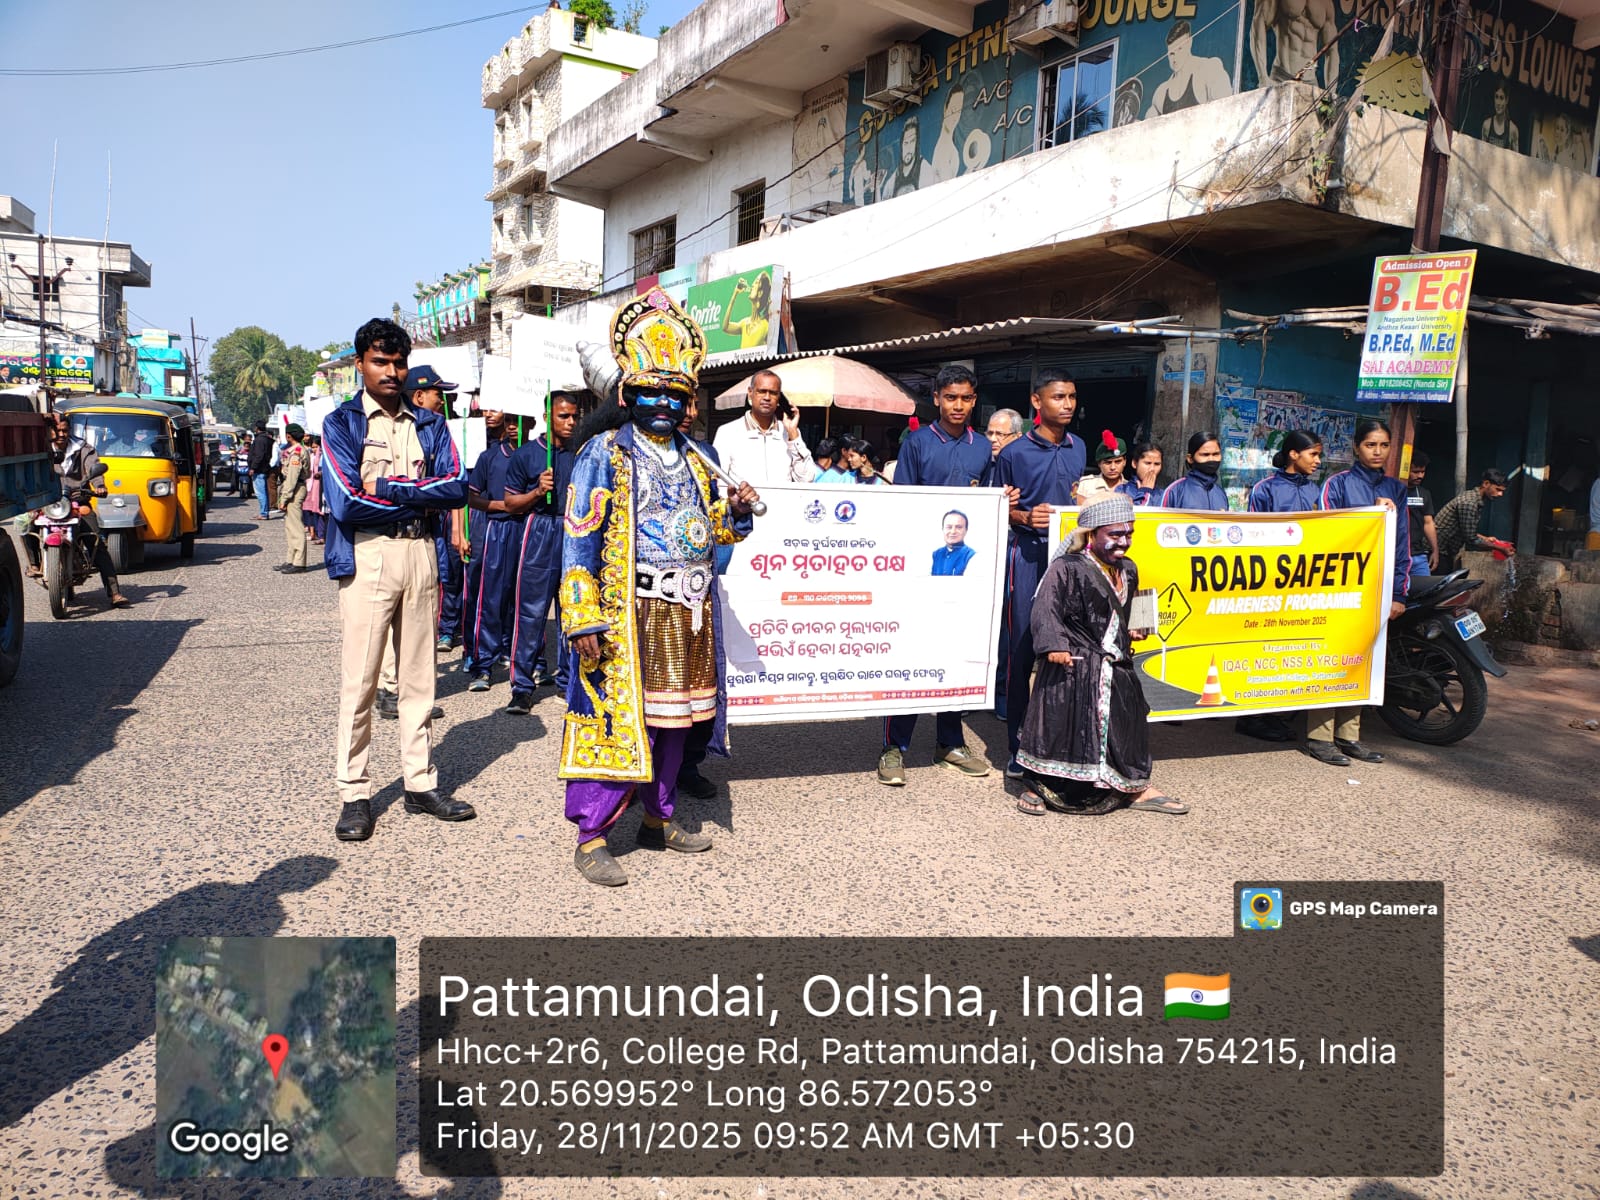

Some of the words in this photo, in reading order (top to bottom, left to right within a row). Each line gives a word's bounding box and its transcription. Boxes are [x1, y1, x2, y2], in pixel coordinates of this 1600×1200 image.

[1518, 29, 1596, 107] LOUNGE
[973, 79, 1012, 109] A/C
[993, 105, 1033, 135] A/C
[1384, 259, 1433, 271] Admission
[1436, 258, 1461, 269] Open
[1374, 272, 1470, 312] B.Ed
[691, 300, 721, 326] Sprite
[1416, 315, 1448, 323] University
[1421, 321, 1452, 330] University
[1369, 333, 1414, 355] B.P.Ed,
[1420, 333, 1456, 352] M.Ed
[1362, 361, 1384, 373] SAI
[1386, 360, 1454, 373] ACADEMY
[850, 538, 876, 549] ଜନିତ
[792, 554, 868, 580] ମୃତାହତ
[873, 555, 905, 572] ପକ୍ଷ
[1190, 554, 1267, 593] ROAD
[1275, 551, 1371, 589] SAFETY
[1206, 596, 1282, 616] AWARENESS
[1284, 592, 1362, 611] PROGRAMME
[1158, 612, 1177, 620] ROAD
[1244, 619, 1259, 628] Date
[1279, 617, 1310, 627] November
[1312, 616, 1327, 626] 2025
[749, 619, 788, 639] ପ୍ରତିଟି
[792, 621, 836, 635] ଜୀବନ
[840, 621, 900, 640] ମୂଲ୍ୟବାନ
[798, 642, 835, 658] ହେବା
[1223, 660, 1251, 673] IQAC,
[1255, 658, 1279, 671] NCC,
[1282, 656, 1303, 668] NSS
[1306, 656, 1313, 667] &
[1316, 655, 1338, 666] YRC
[1341, 654, 1364, 666] Units
[857, 670, 883, 680] ଭାବେ
[885, 669, 911, 681] ଘରକୁ
[1243, 687, 1288, 699] collaboration
[1290, 686, 1303, 695] with
[1306, 685, 1320, 693] RTO
[1323, 682, 1359, 692] Kendrapara
